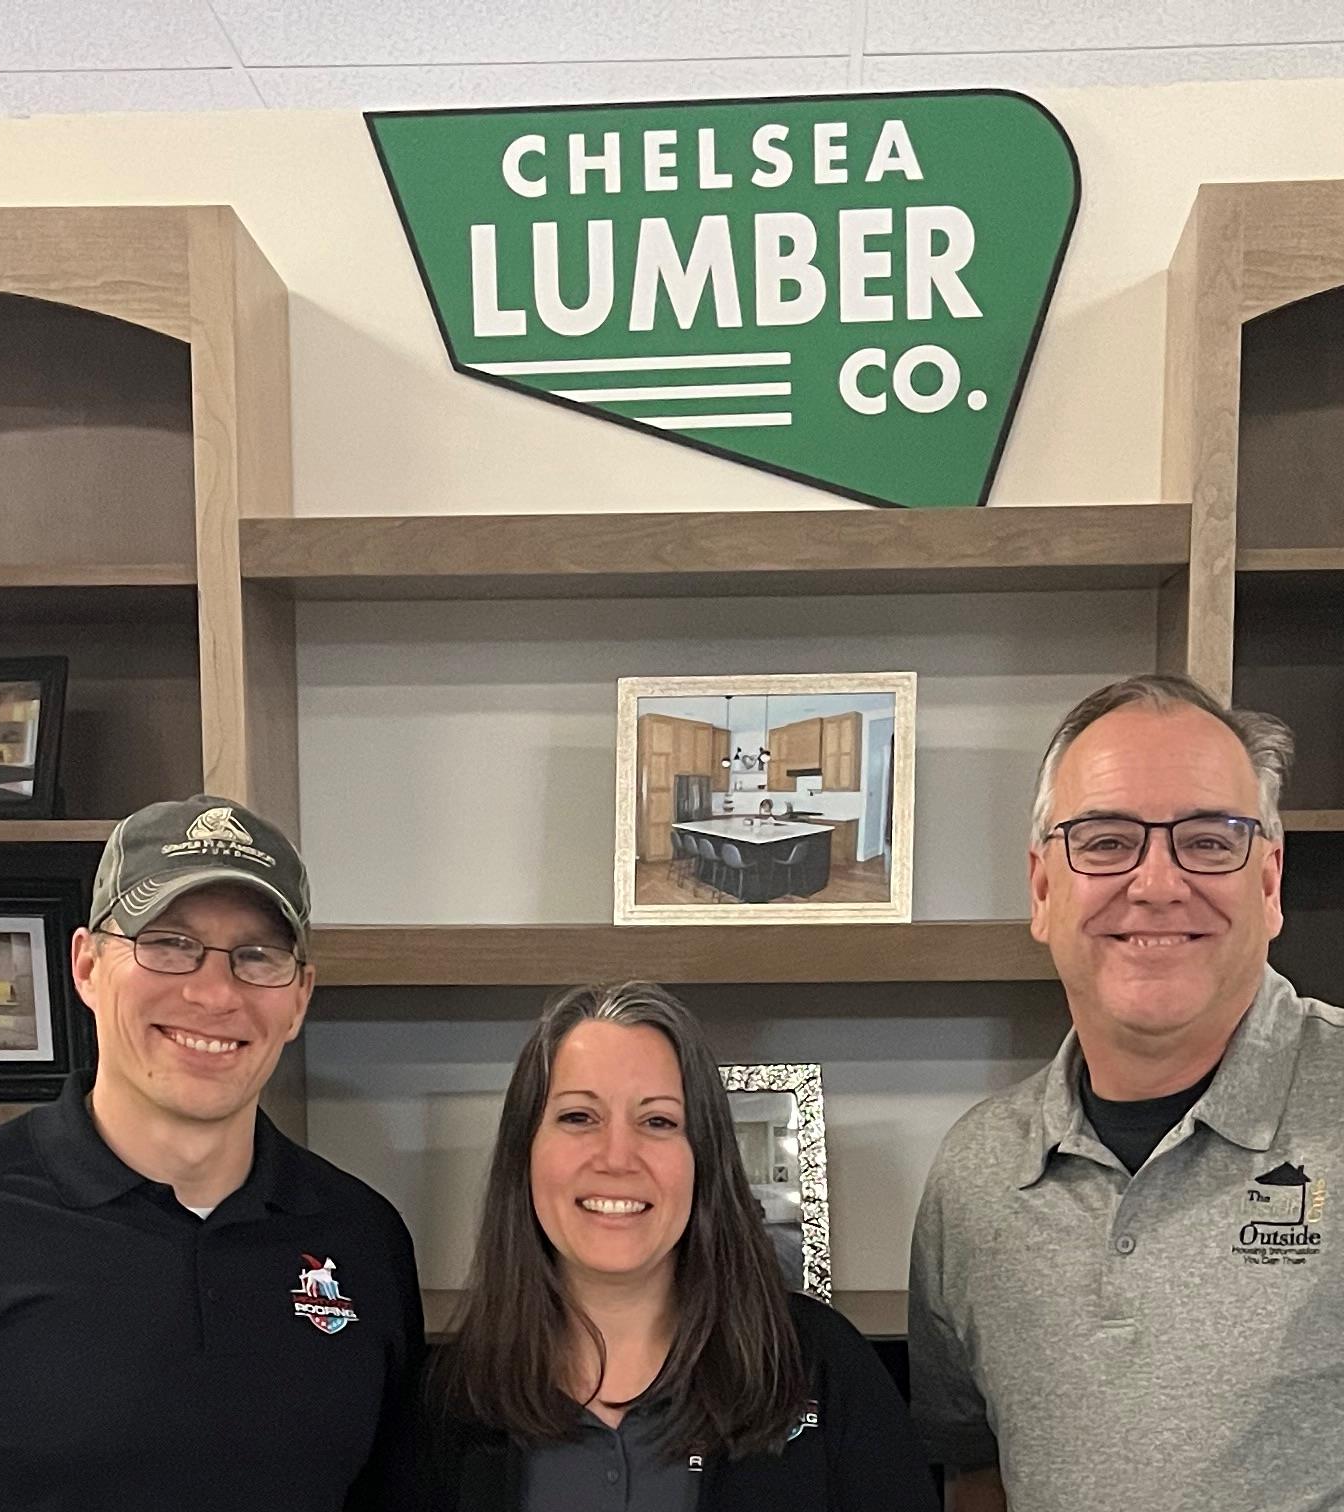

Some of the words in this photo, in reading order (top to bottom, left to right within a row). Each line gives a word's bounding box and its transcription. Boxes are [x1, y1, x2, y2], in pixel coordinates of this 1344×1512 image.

[502, 119, 924, 199] CHELSEA
[469, 205, 984, 338] LUMBER
[839, 344, 988, 415] CO.
[1239, 1225, 1321, 1246] Outside
